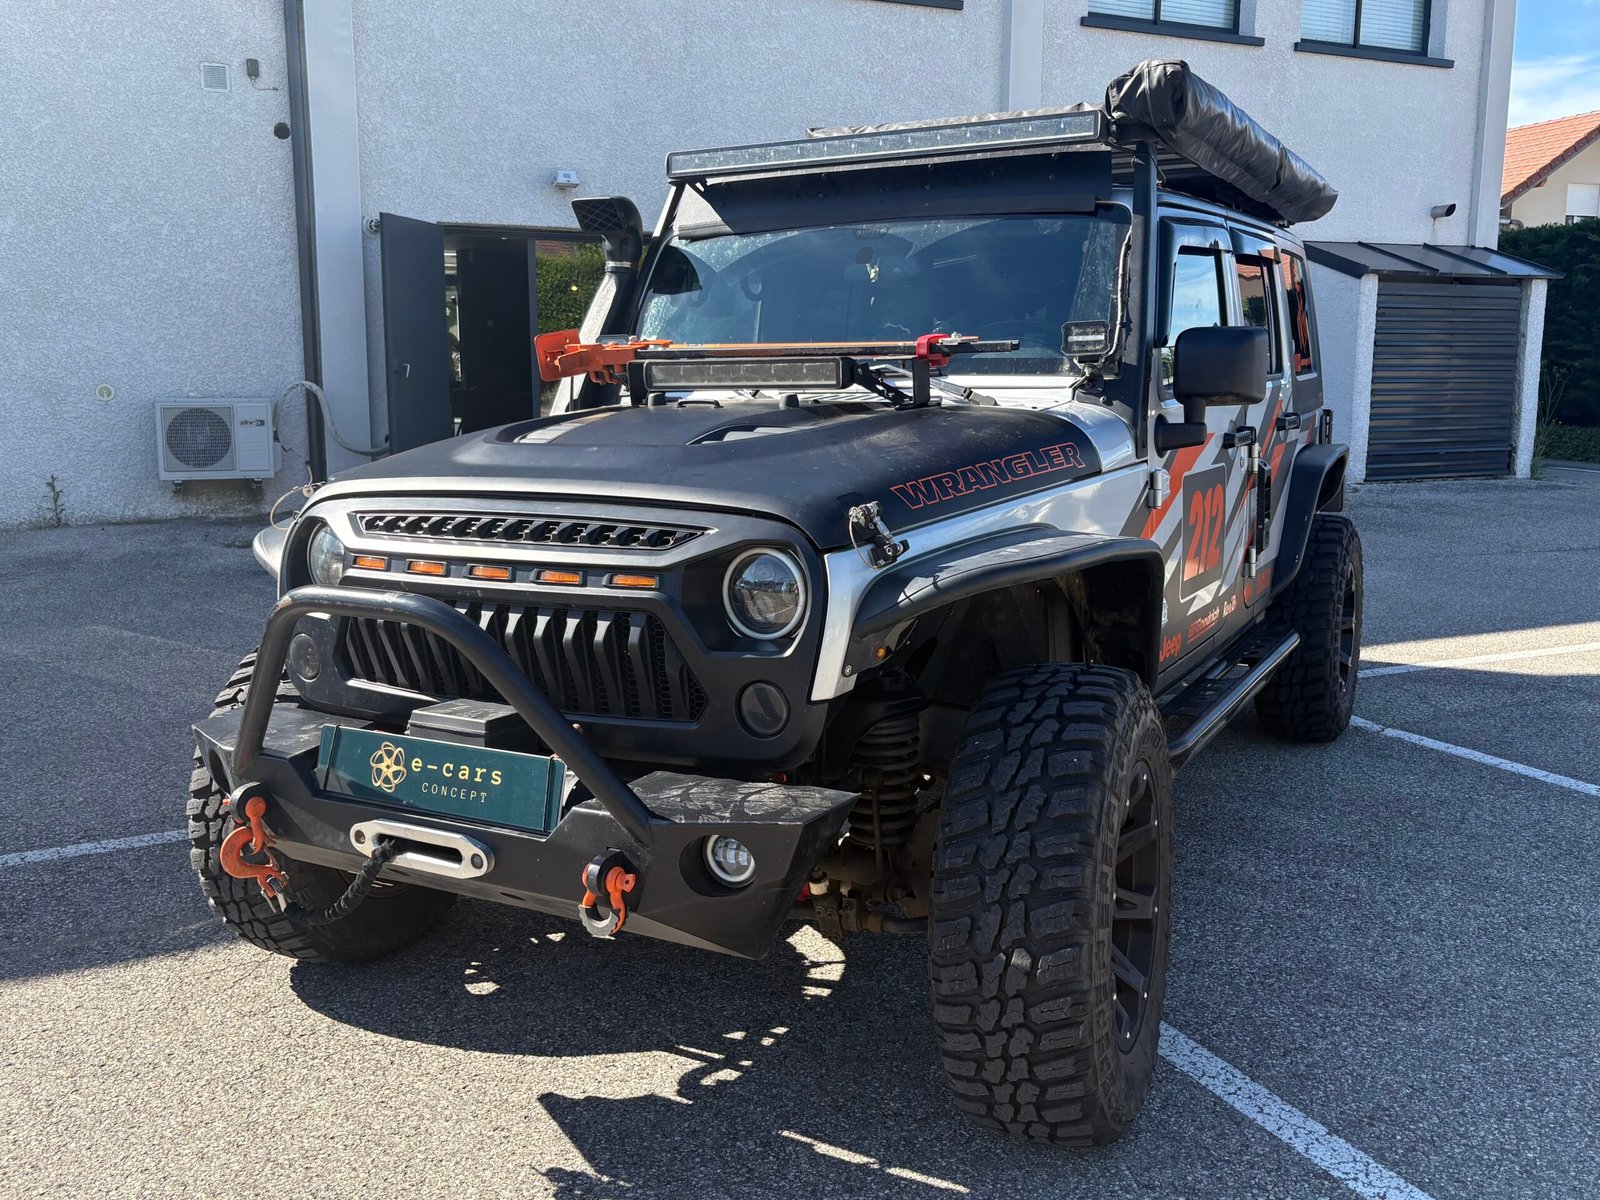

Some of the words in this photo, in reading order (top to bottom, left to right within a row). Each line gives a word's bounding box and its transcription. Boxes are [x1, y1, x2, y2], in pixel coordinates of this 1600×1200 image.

[891, 443, 1085, 509] WRANGLER
[1184, 484, 1224, 581] 212
[1160, 633, 1182, 661] Jeep
[411, 757, 503, 785] e-cars
[421, 782, 488, 803] CONCEPT
